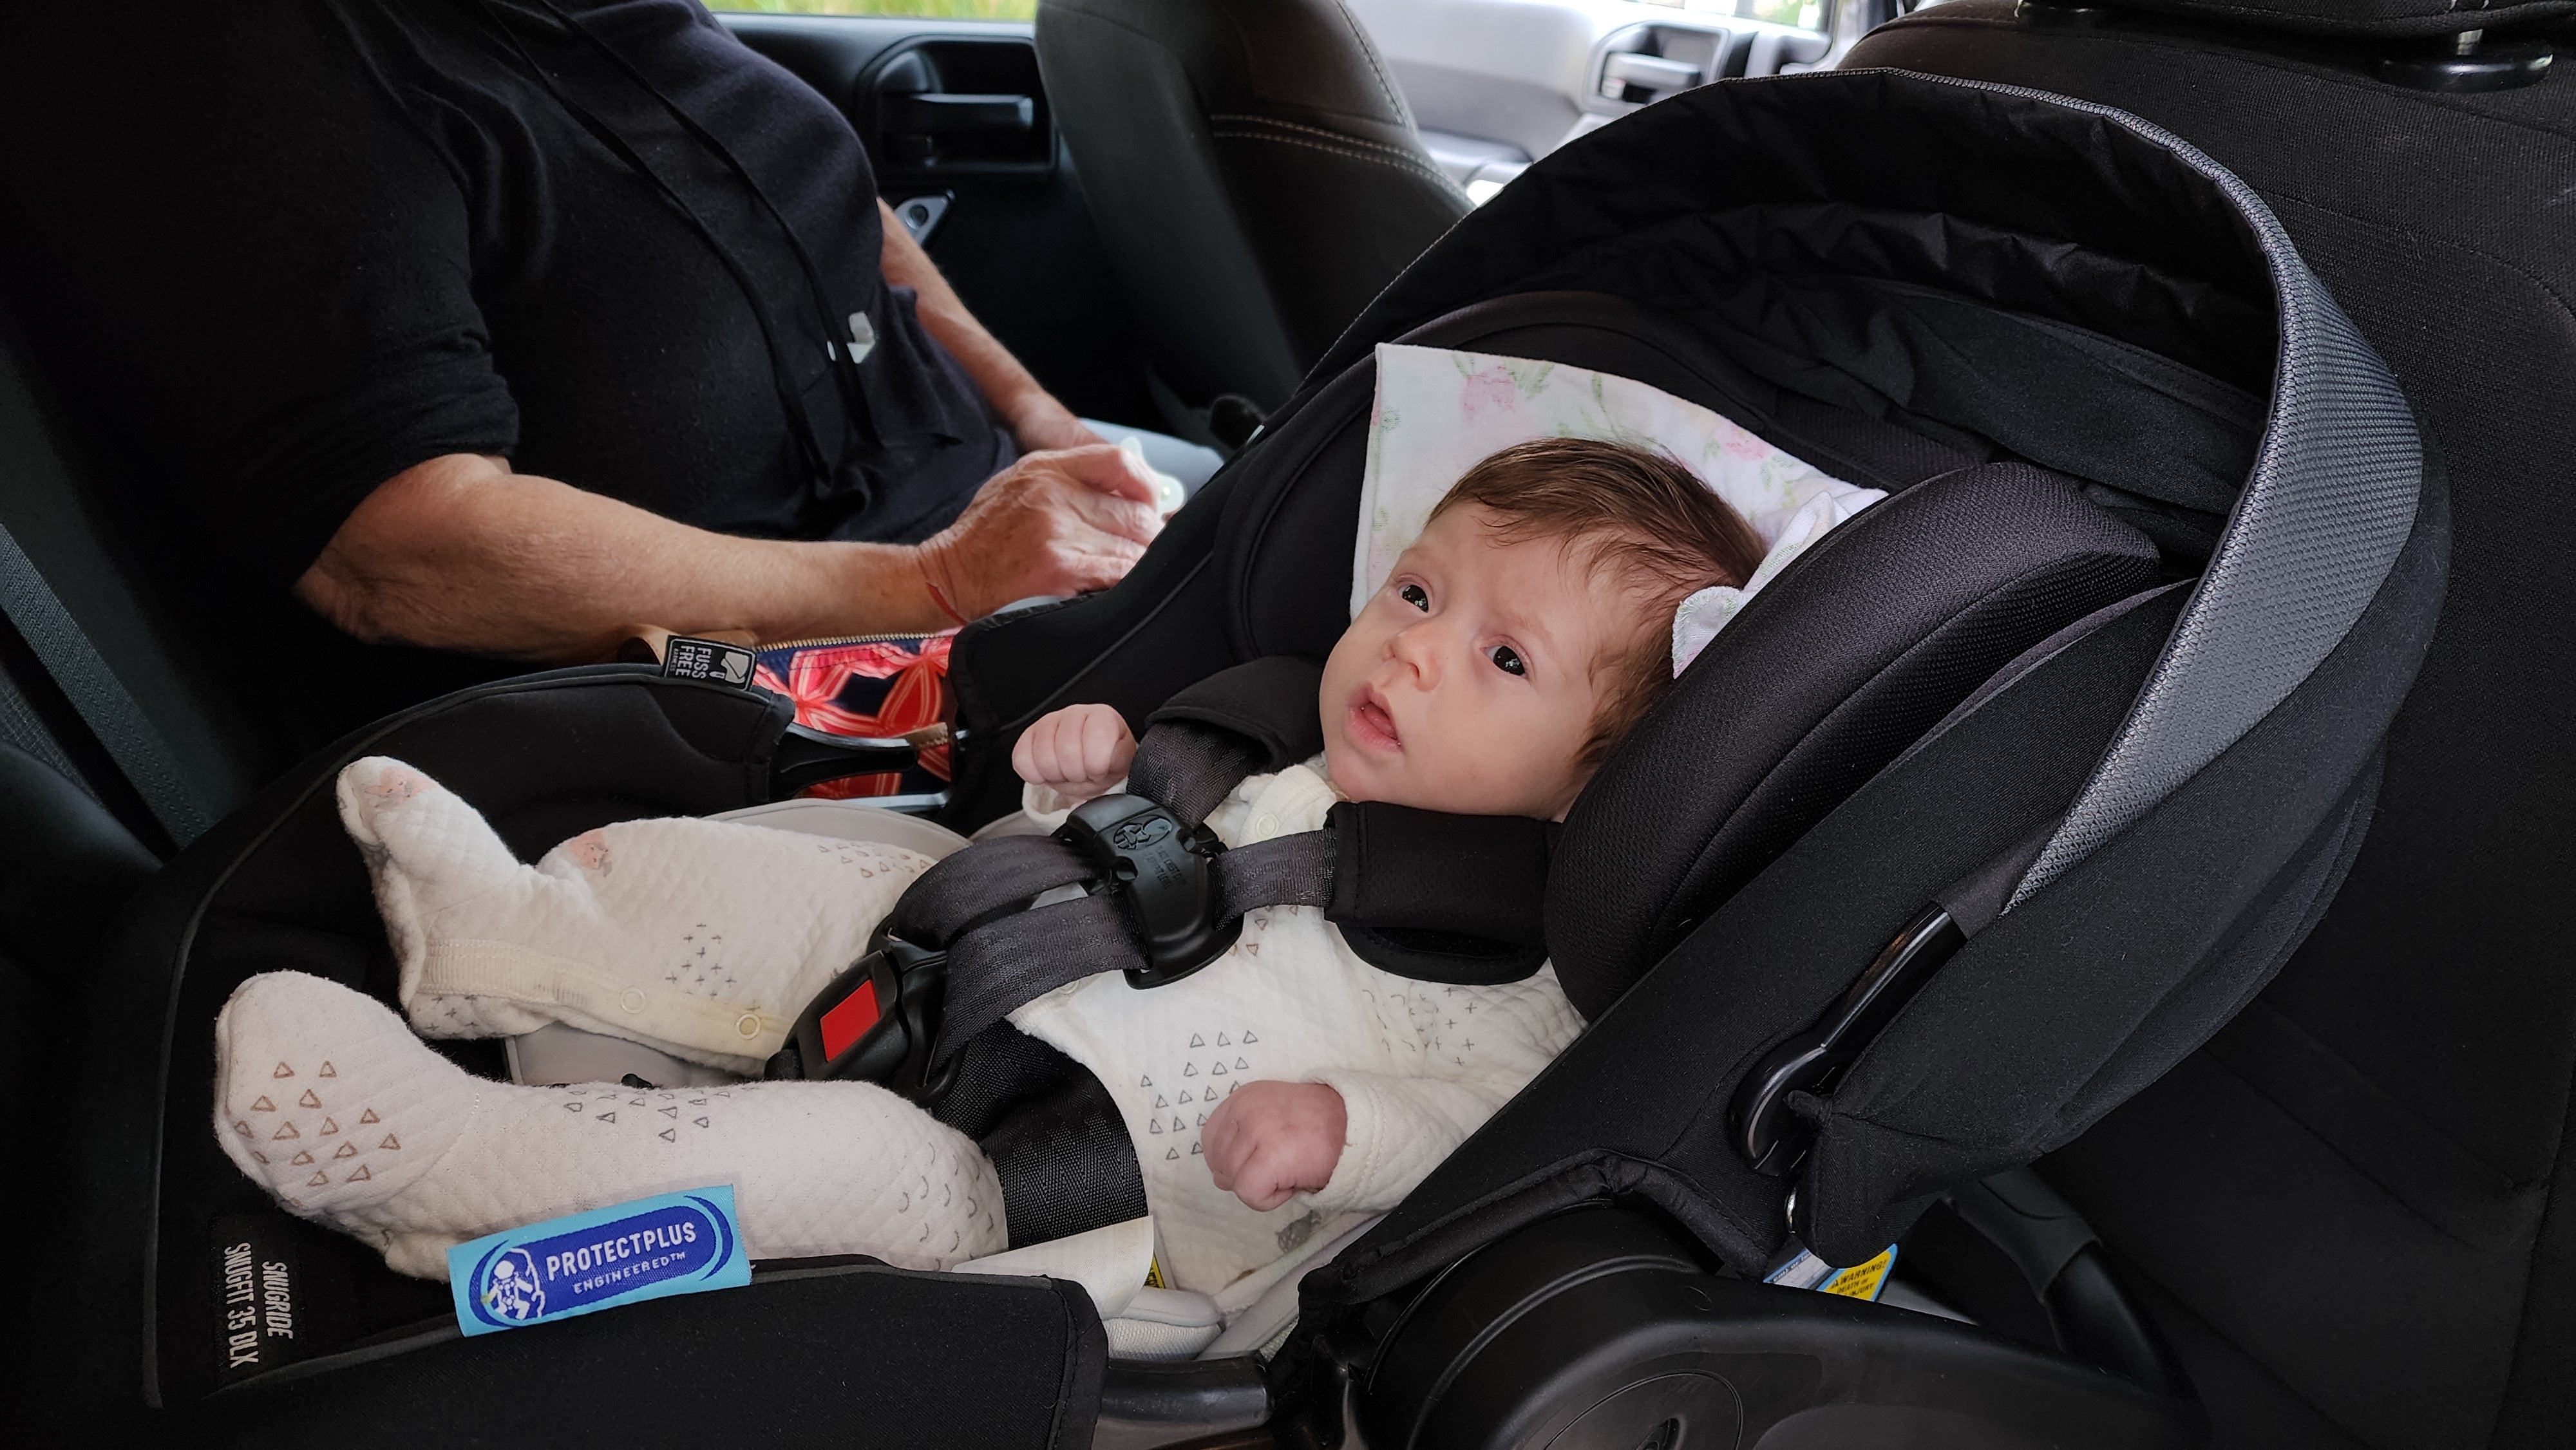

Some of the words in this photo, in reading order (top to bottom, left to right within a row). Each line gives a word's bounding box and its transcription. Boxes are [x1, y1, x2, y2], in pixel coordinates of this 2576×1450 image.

[676, 645, 695, 676] FREE
[692, 646, 712, 679] FUSS
[546, 1222, 697, 1281] PROTECTPLUS
[224, 1243, 255, 1304] SNUGFIT
[1841, 1260, 1886, 1283] WARNING!
[261, 1261, 293, 1339] SNUGRIDE
[227, 1306, 256, 1330] 35
[228, 1330, 259, 1368] DLX
